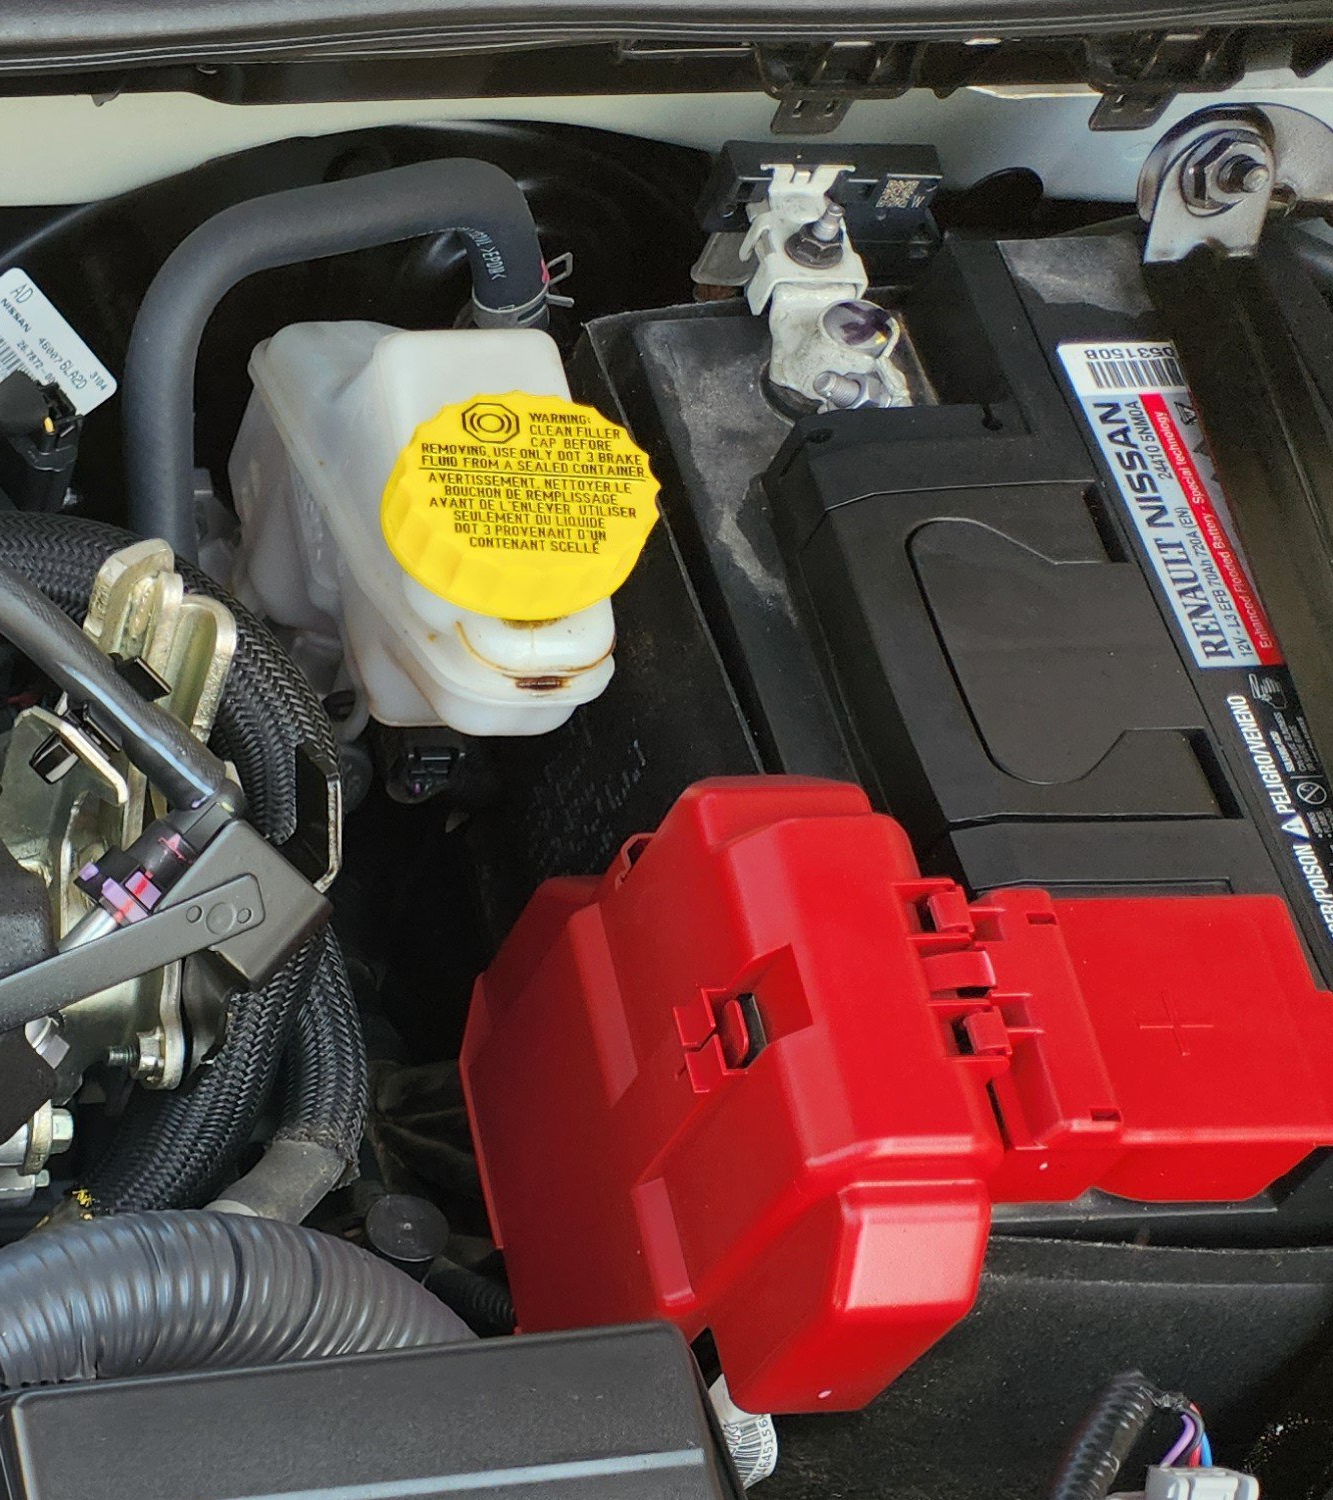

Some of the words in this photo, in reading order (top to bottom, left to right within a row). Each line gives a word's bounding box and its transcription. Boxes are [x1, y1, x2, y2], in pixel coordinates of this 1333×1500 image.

[10, 283, 34, 304] AD
[0, 298, 32, 333] NISSAN
[529, 412, 592, 425] WARNING:
[530, 425, 572, 437] CLEAN
[576, 427, 621, 440] FILLER
[531, 438, 557, 449] CAP
[564, 439, 612, 451] BEFORE
[422, 456, 458, 468] FLUID
[463, 458, 500, 470] FROM
[504, 460, 513, 471] A
[518, 461, 569, 473] SEALED
[493, 447, 517, 458] USE
[520, 449, 552, 461] ONLY
[557, 452, 583, 463] DOT
[587, 453, 594, 463] 3
[599, 453, 643, 466] BRAKE
[1092, 401, 1174, 529] NISSAN
[444, 486, 501, 498] BOUCHON
[506, 488, 520, 500] DE
[526, 490, 618, 505] REMPLISSAGE
[545, 479, 611, 493] NETTOYER
[616, 482, 632, 494] LE
[430, 497, 474, 509] AVANT
[479, 499, 494, 510] DE
[499, 500, 571, 514] L'ENLEVER
[579, 506, 637, 519] UTILISER
[454, 511, 530, 525] SEULEMENT
[535, 515, 552, 526] DU
[556, 515, 605, 529] LIQUIDE
[454, 523, 480, 534] DOT
[484, 525, 491, 535] 3
[495, 525, 572, 539] PROVENANT
[470, 537, 546, 552] CONTENANT
[550, 536, 600, 554] SCELLÉ
[1152, 539, 1234, 660] RENAULT
[1237, 597, 1273, 649] Enhanced
[1227, 692, 1296, 815] PELIGRO/VENENO
